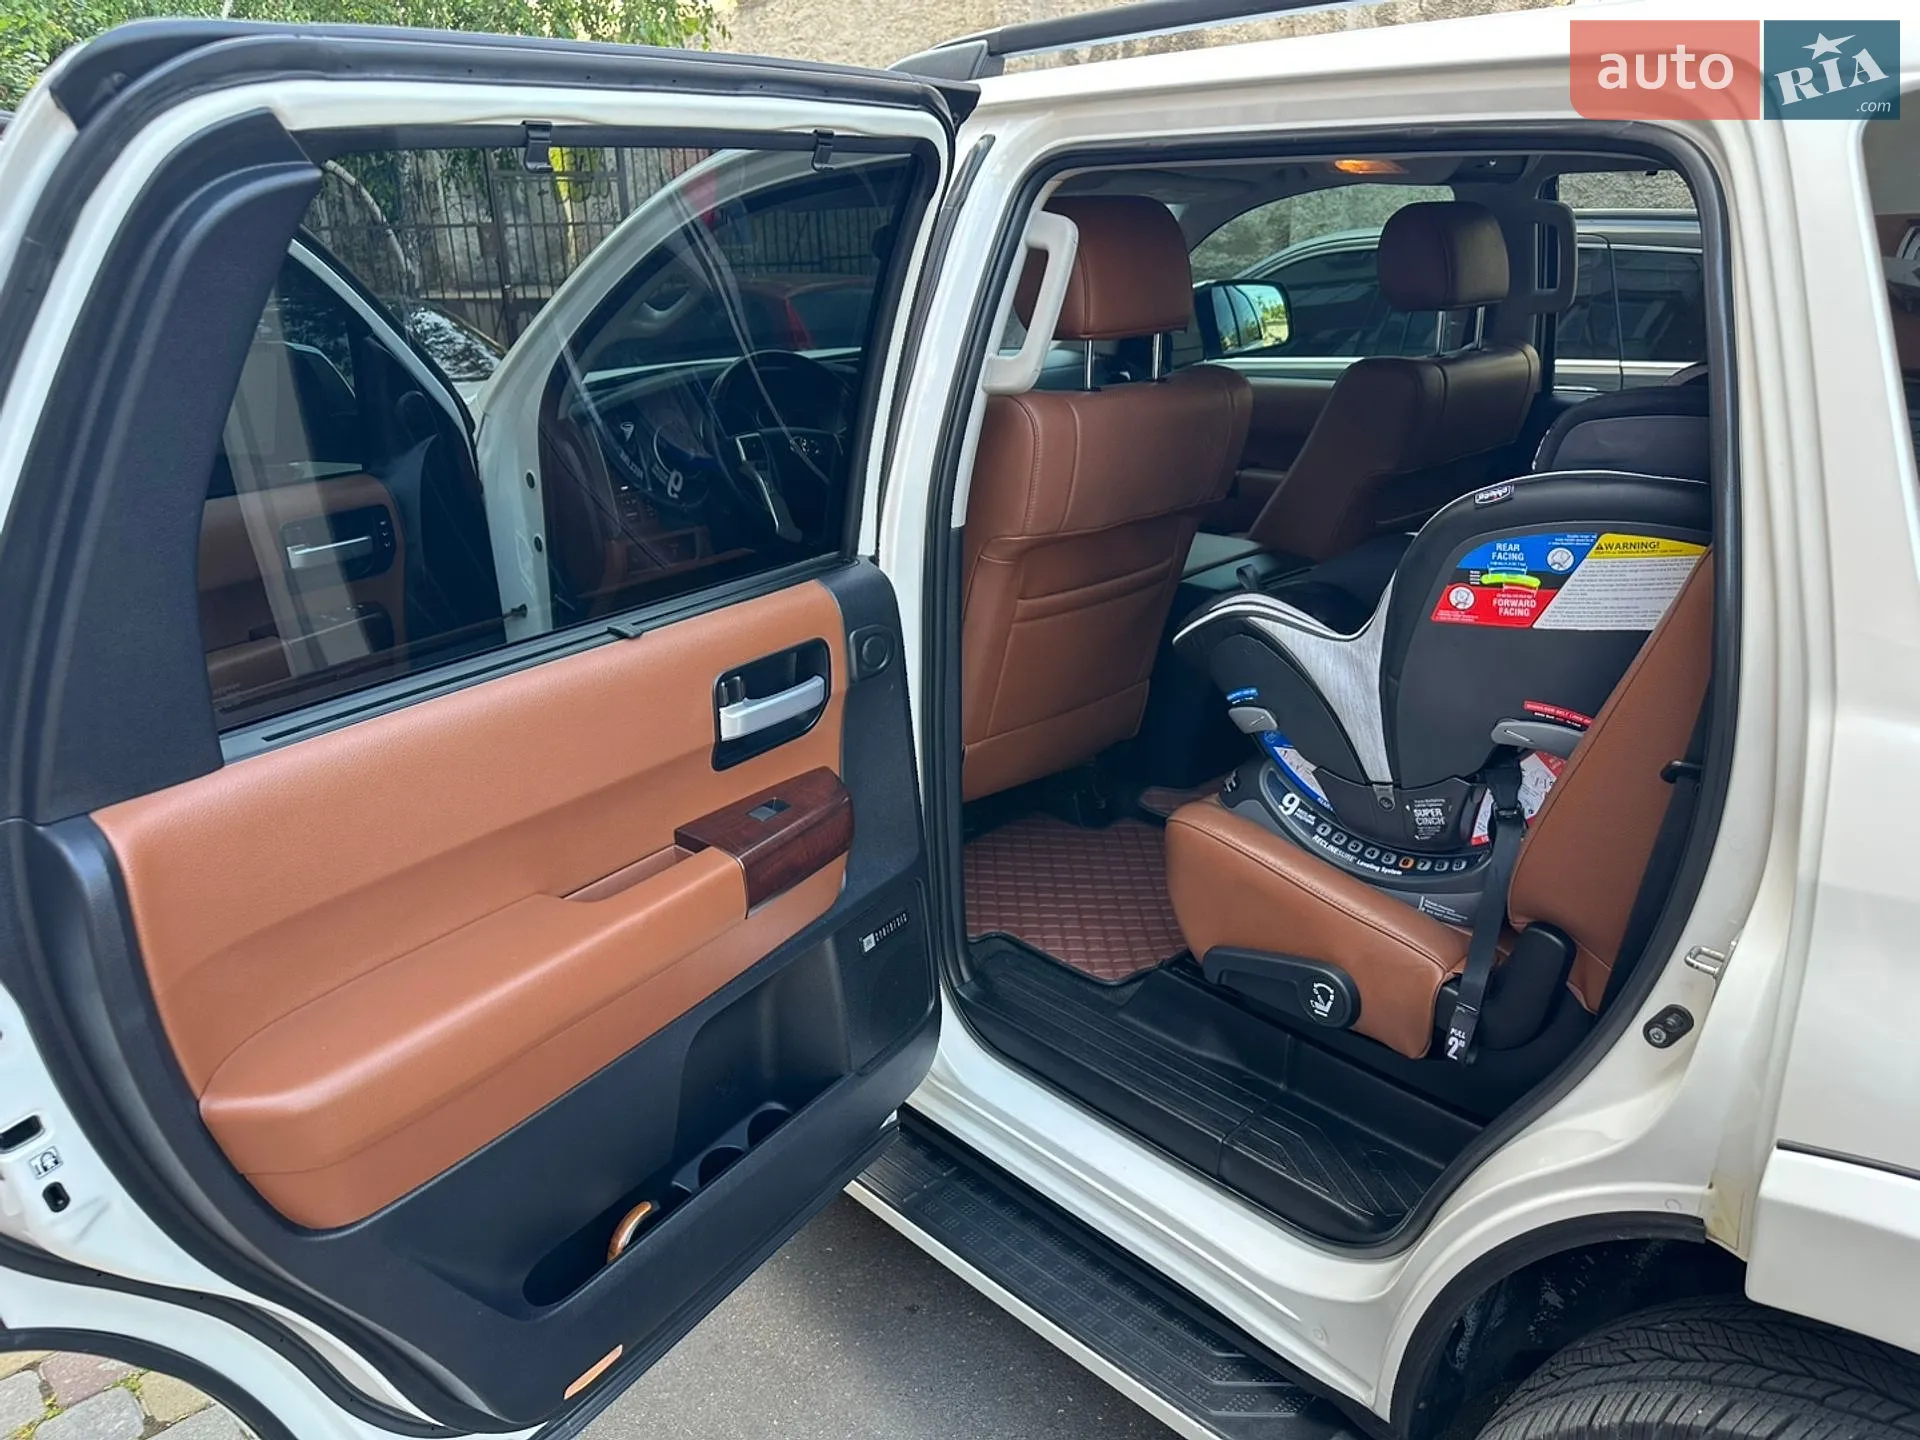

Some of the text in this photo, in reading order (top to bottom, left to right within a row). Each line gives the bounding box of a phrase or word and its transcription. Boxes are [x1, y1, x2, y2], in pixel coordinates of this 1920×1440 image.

[1496, 543, 1520, 552] REAR
[1605, 541, 1660, 551] WARNING!
[1492, 552, 1524, 561] FACING
[1493, 598, 1536, 608] FORWARD
[1499, 608, 1530, 617] FACING
[1278, 793, 1300, 816] 9
[1414, 808, 1443, 817] SUPER
[1415, 817, 1446, 826] CINCH
[1450, 1028, 1466, 1039] PULL
